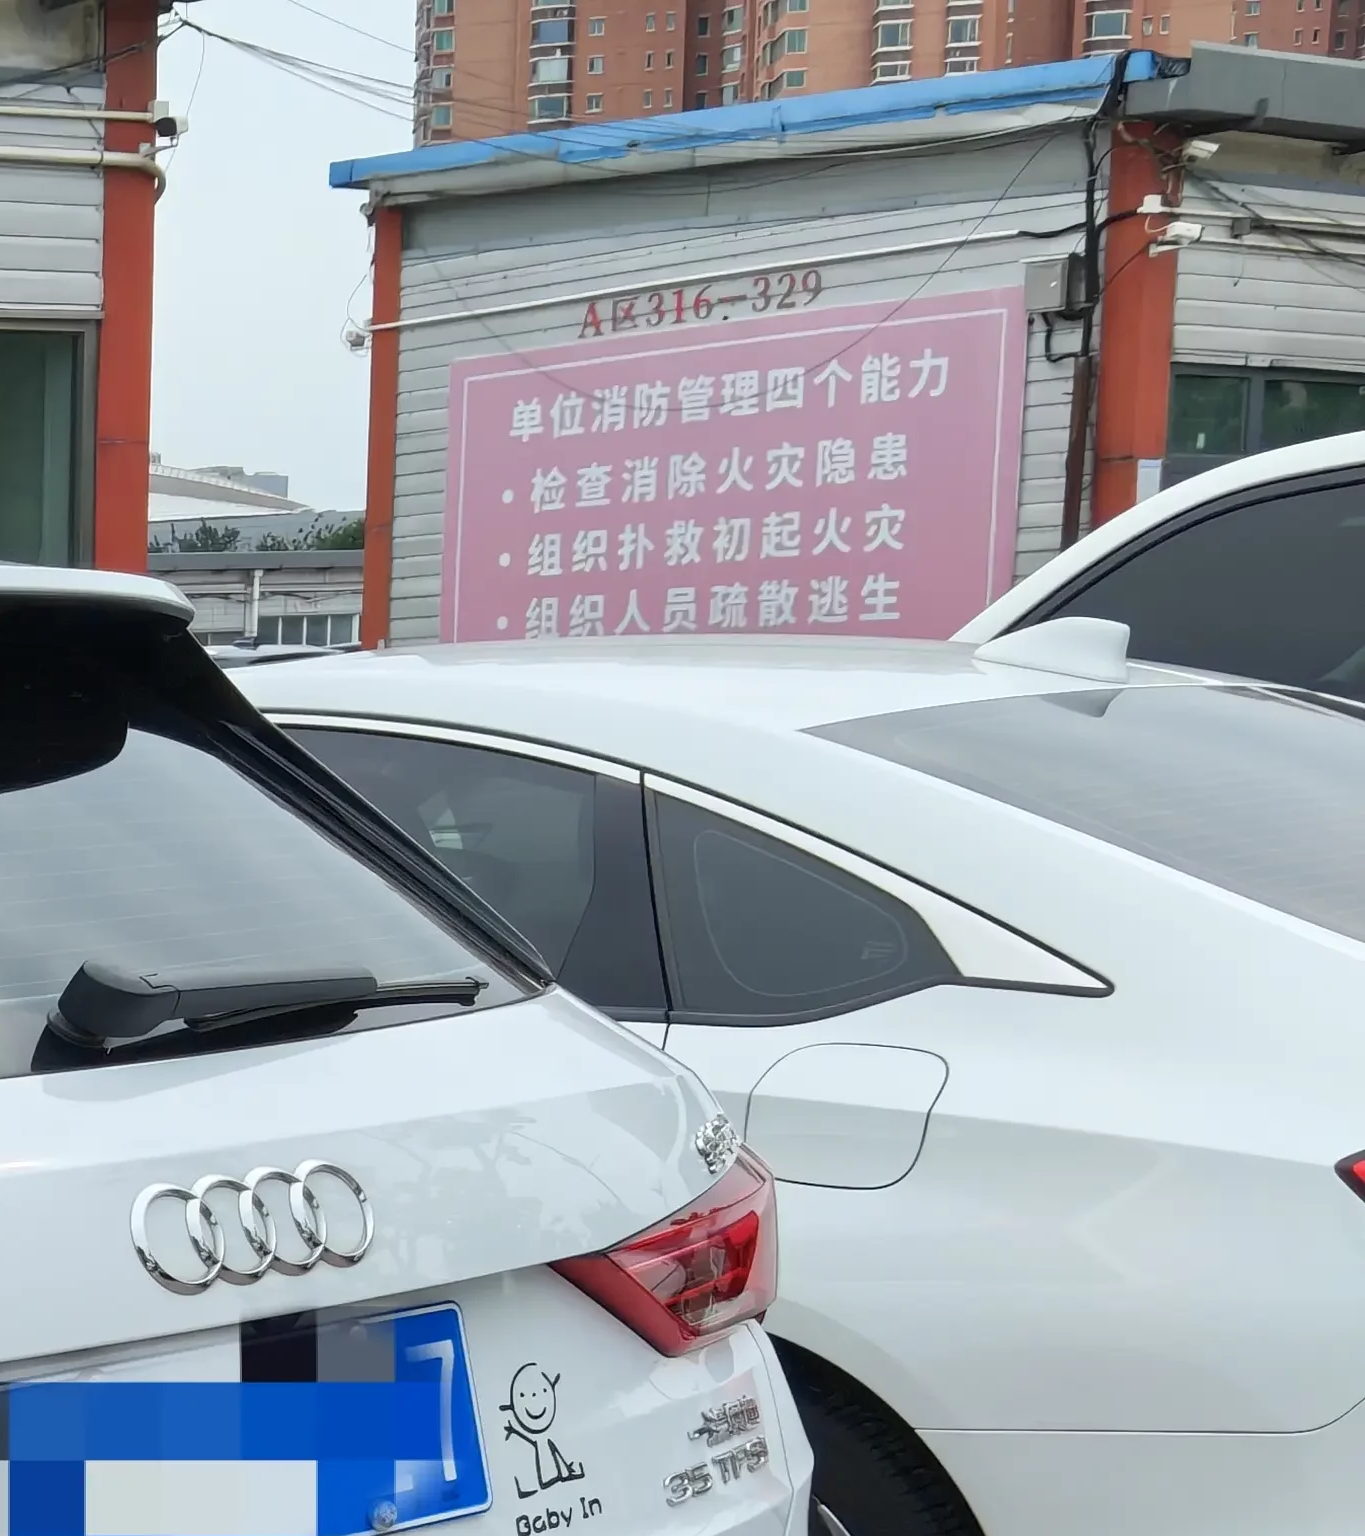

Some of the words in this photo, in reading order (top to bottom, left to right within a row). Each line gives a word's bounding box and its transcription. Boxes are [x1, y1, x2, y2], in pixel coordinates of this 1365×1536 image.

[508, 350, 950, 443] 单位消防管理四个能力
[529, 431, 909, 514] 检查消除火灾隐患
[527, 505, 906, 578] 组织扑救初起火灾
[524, 572, 901, 639] 组织人员疏散逃生
[579, 1496, 602, 1519] In
